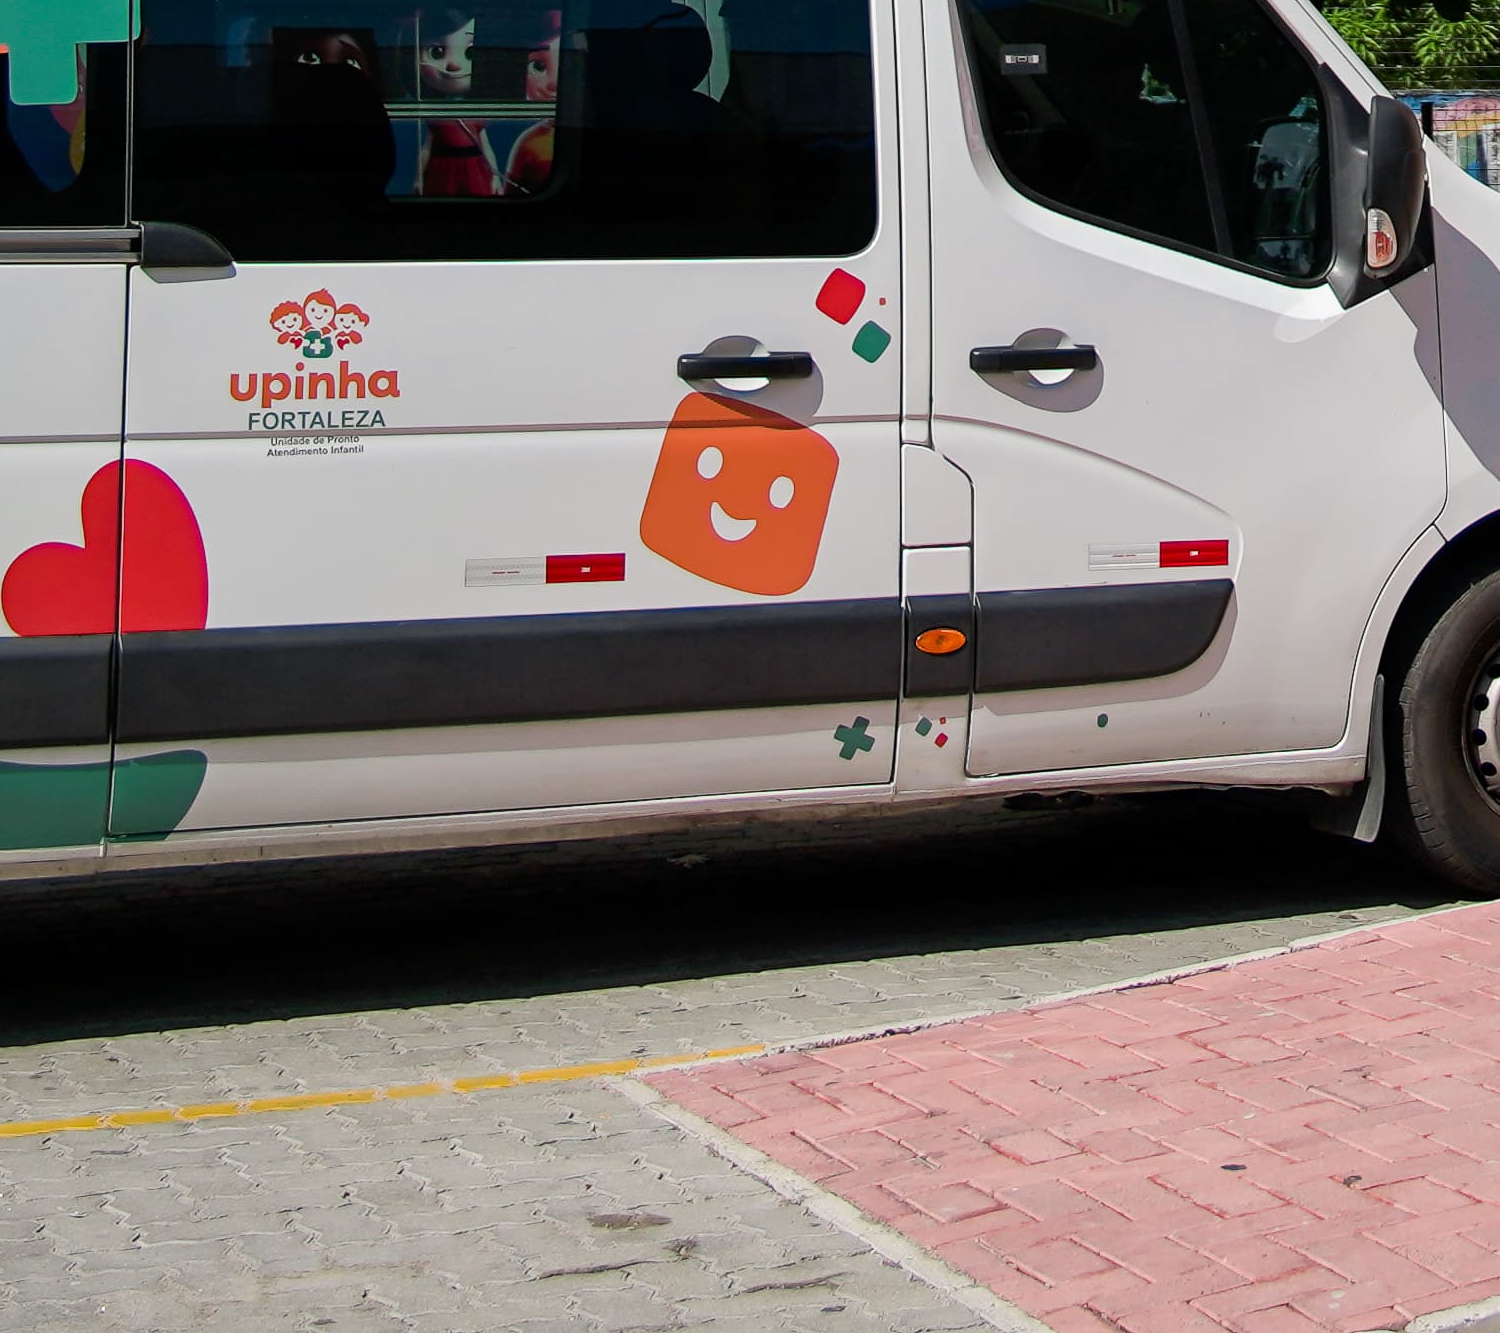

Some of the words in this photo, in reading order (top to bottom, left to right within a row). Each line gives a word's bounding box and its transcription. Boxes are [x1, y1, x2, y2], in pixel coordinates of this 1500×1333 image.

[229, 361, 400, 408] upinha
[248, 410, 386, 430] FORTALEZA
[270, 437, 310, 446] Unidade
[313, 436, 324, 444] de
[327, 435, 359, 444] Pronto
[267, 447, 328, 457] Atendimento
[331, 445, 364, 454] Infantil
